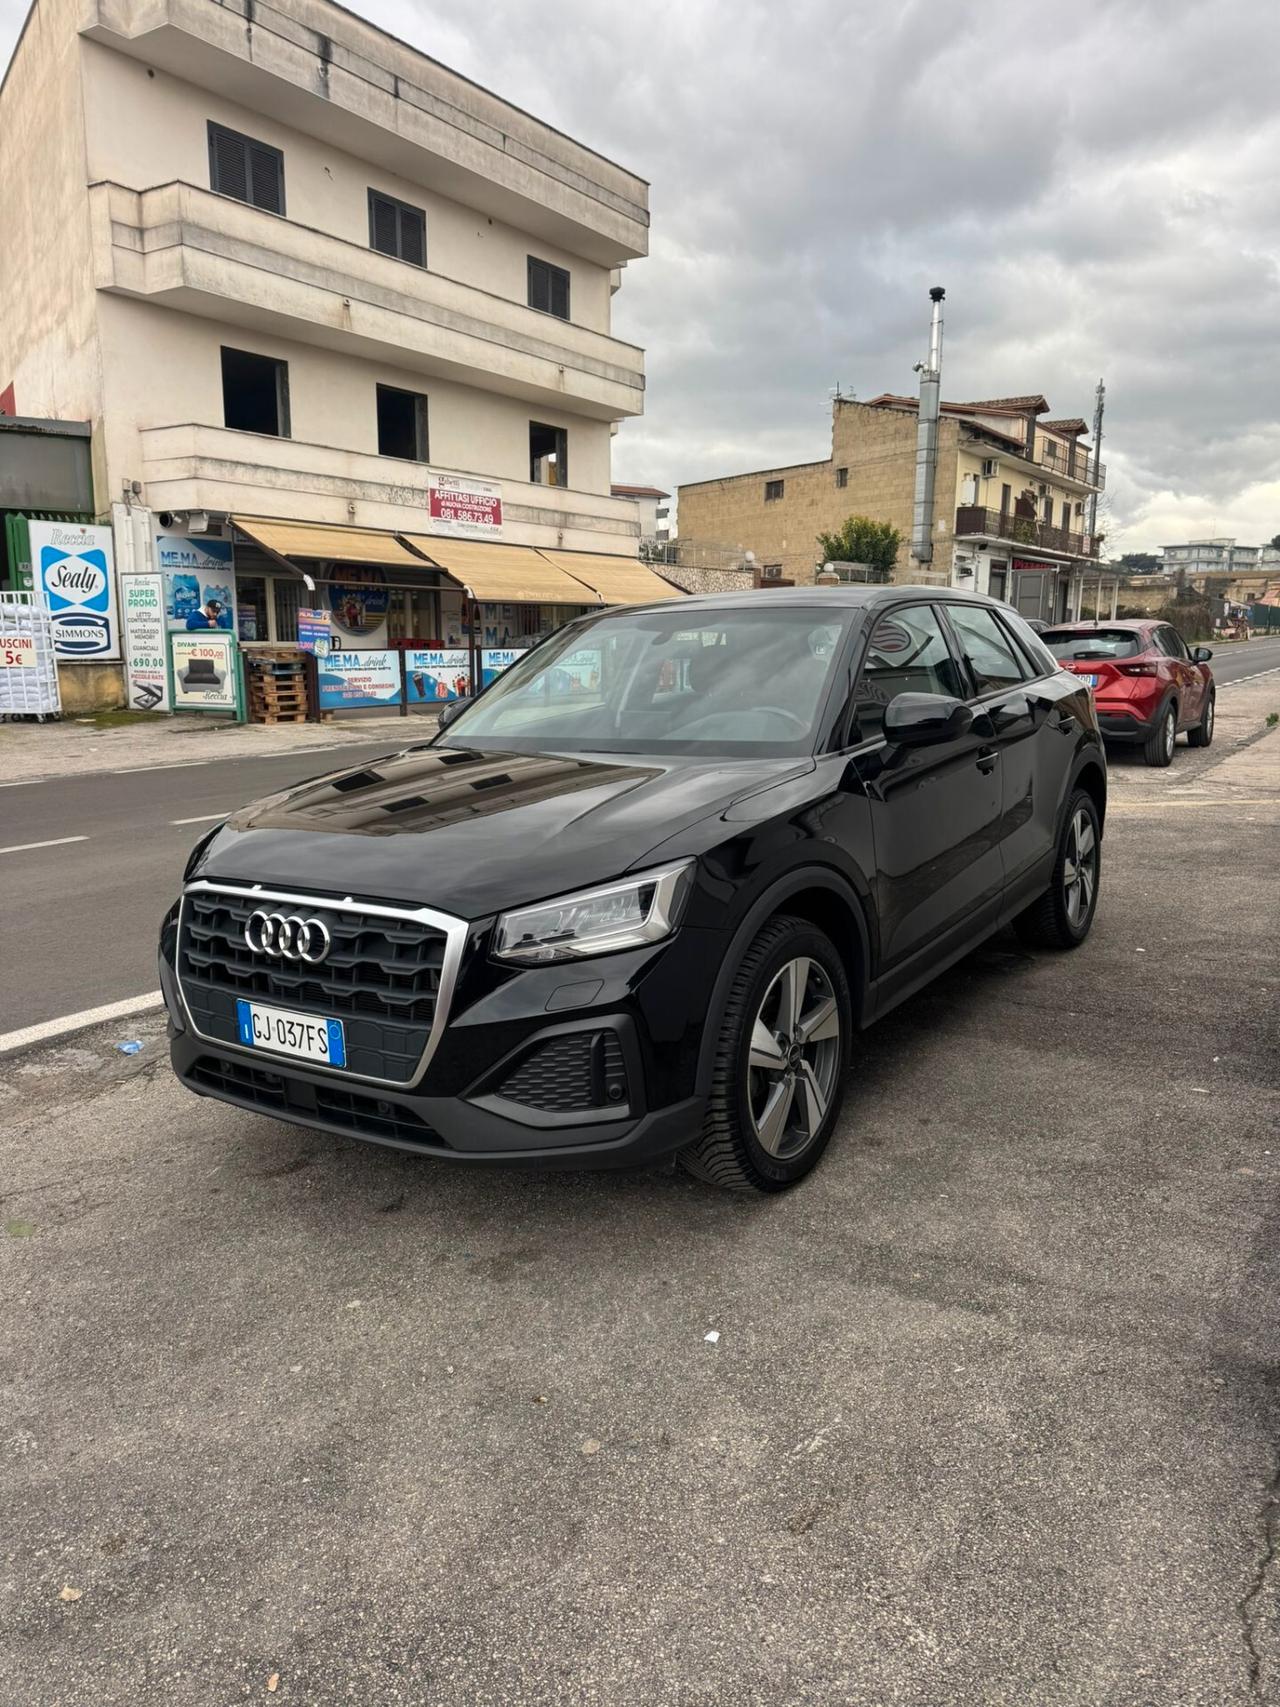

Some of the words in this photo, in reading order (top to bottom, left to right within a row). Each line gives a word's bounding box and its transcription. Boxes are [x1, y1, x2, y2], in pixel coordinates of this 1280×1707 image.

[434, 490, 470, 504] AFFITTASI
[471, 494, 497, 508] UFFICIO
[446, 501, 462, 509] NUOVA
[52, 565, 97, 593] Sealy
[129, 589, 156, 598] SUPER
[128, 599, 158, 608] PROMO
[56, 628, 104, 639] SIMMONS
